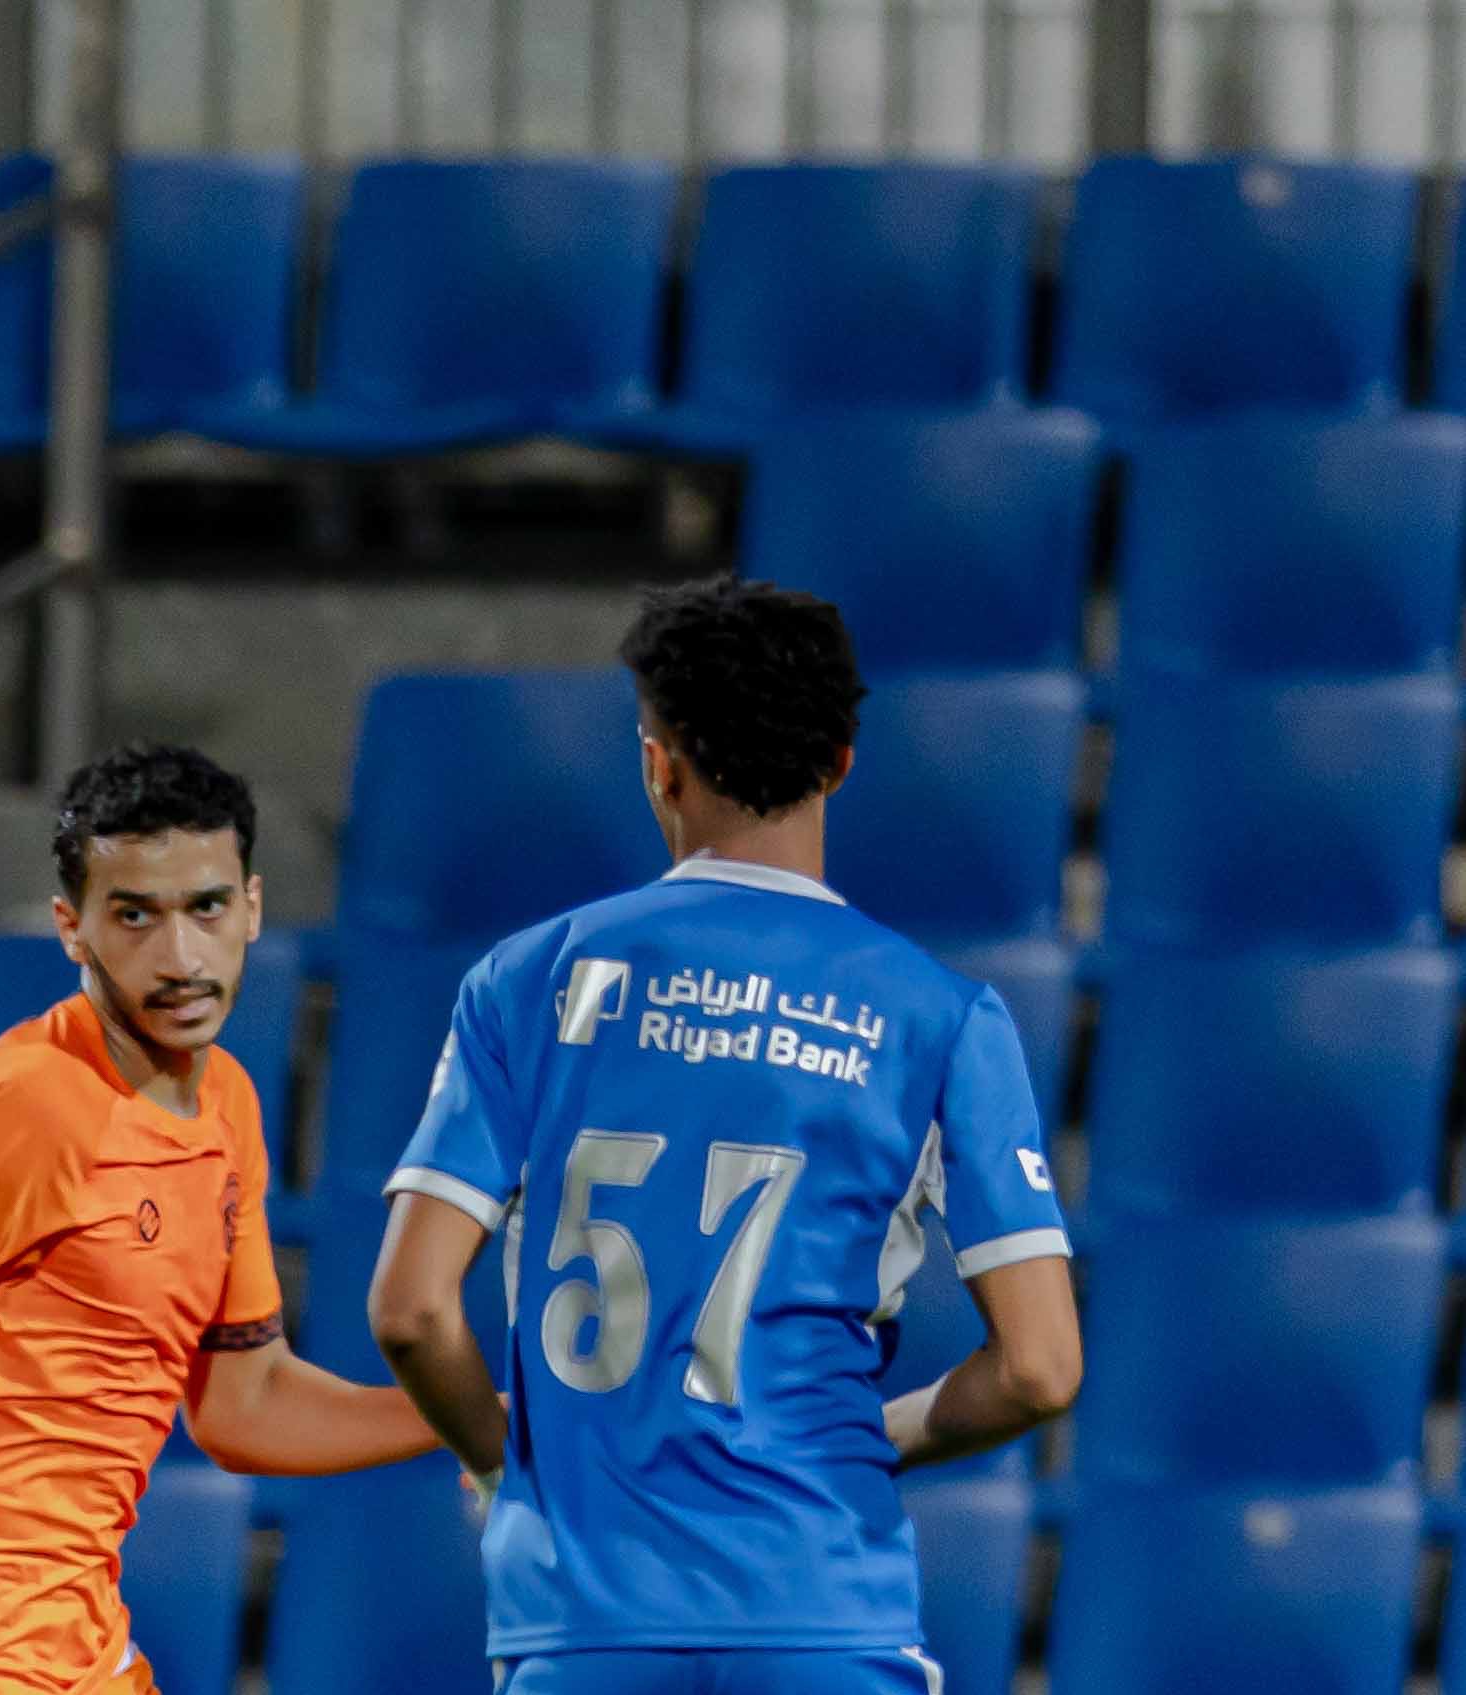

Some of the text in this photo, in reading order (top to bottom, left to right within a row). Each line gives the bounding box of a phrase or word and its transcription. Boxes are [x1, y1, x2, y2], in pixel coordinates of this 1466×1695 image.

[638, 1010, 872, 1087] Riyad Bank
[646, 967, 885, 1049] بنك الرياض
[541, 1128, 808, 1407] 57
